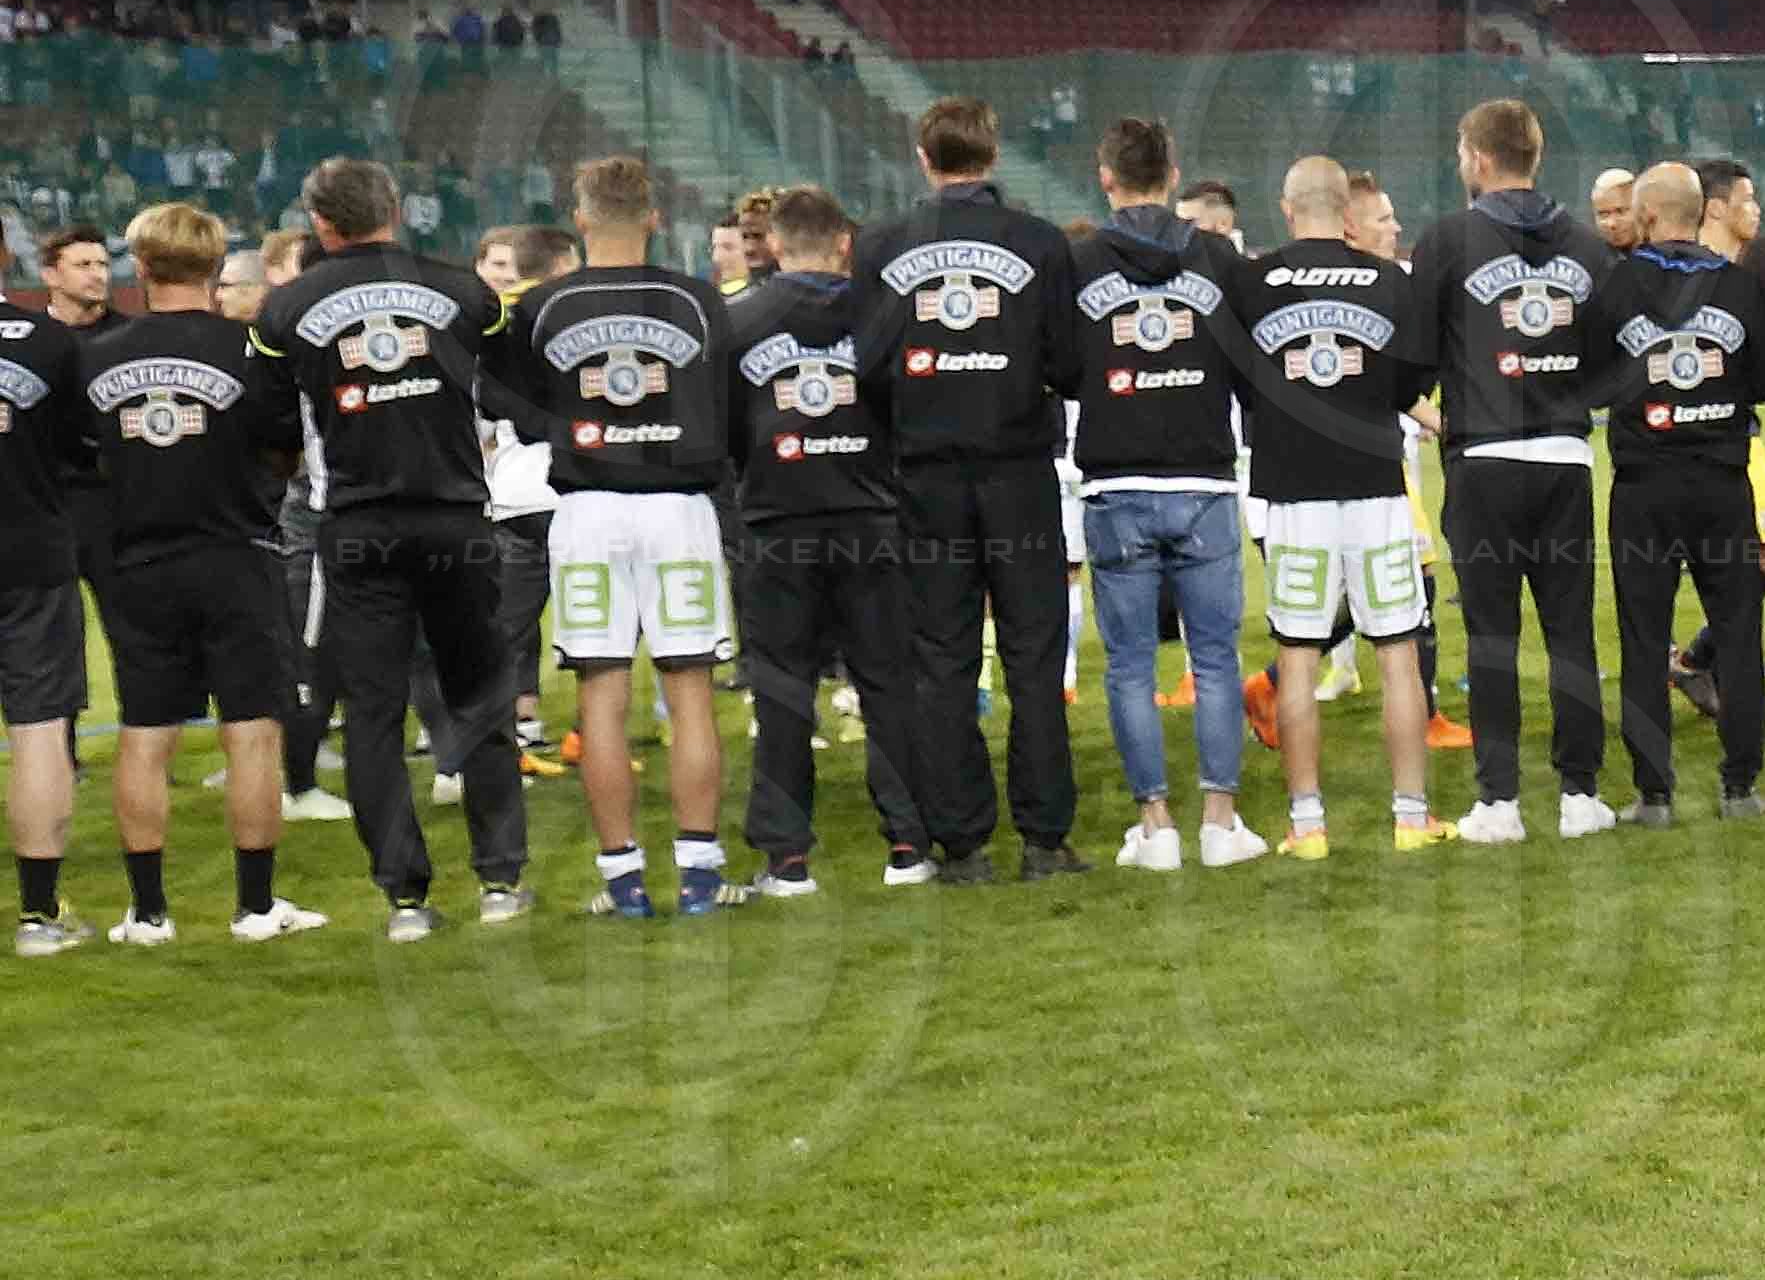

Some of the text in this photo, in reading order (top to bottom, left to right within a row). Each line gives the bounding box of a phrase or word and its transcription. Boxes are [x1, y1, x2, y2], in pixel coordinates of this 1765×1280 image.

[888, 246, 1029, 290] PUNTIGAMER
[1291, 267, 1380, 287] LOTTO
[307, 289, 452, 338] PUNTIGAMER
[1260, 305, 1390, 349] PUNTIGAMER
[550, 322, 692, 366] PUNTIGAMER
[94, 364, 234, 401] PUNTIGAMER
